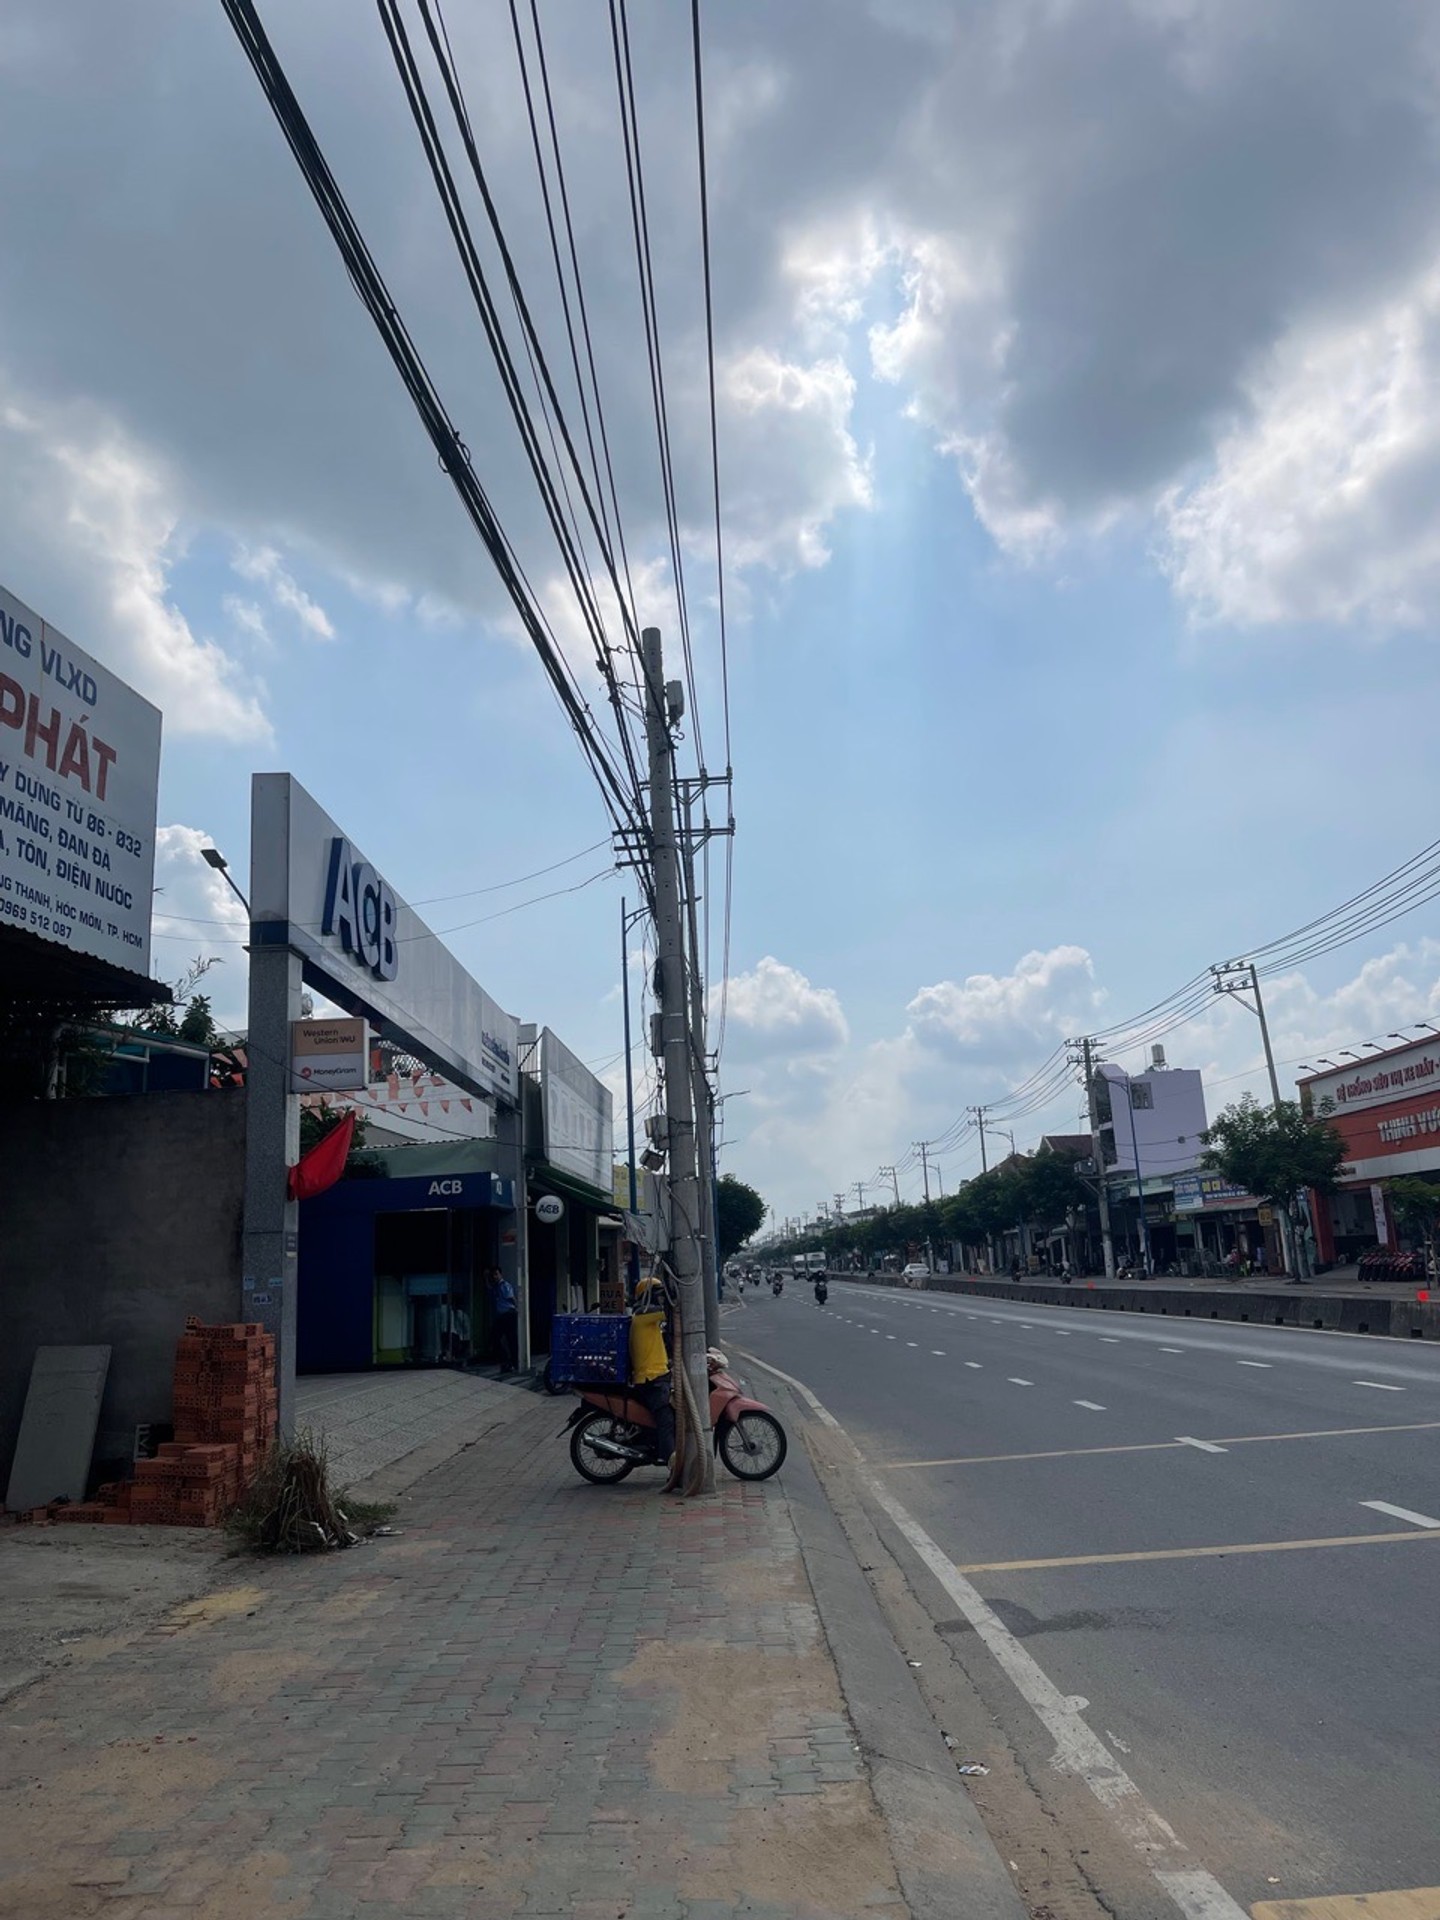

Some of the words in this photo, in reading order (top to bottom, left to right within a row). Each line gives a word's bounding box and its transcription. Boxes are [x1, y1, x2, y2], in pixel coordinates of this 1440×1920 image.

[41, 639, 97, 706] VLXD
[0, 671, 117, 801] PHÁT
[16, 837, 51, 877] TÔN,
[56, 858, 91, 892] ĐIỆN
[322, 837, 398, 982] ACB
[30, 911, 50, 931] 512
[52, 921, 72, 939] 087
[122, 930, 143, 949] HCM
[303, 1029, 339, 1037] Western
[313, 1036, 339, 1045] Union
[313, 1067, 357, 1076] MoneyGram
[428, 1180, 463, 1195] ACB
[538, 1205, 560, 1215] ACB
